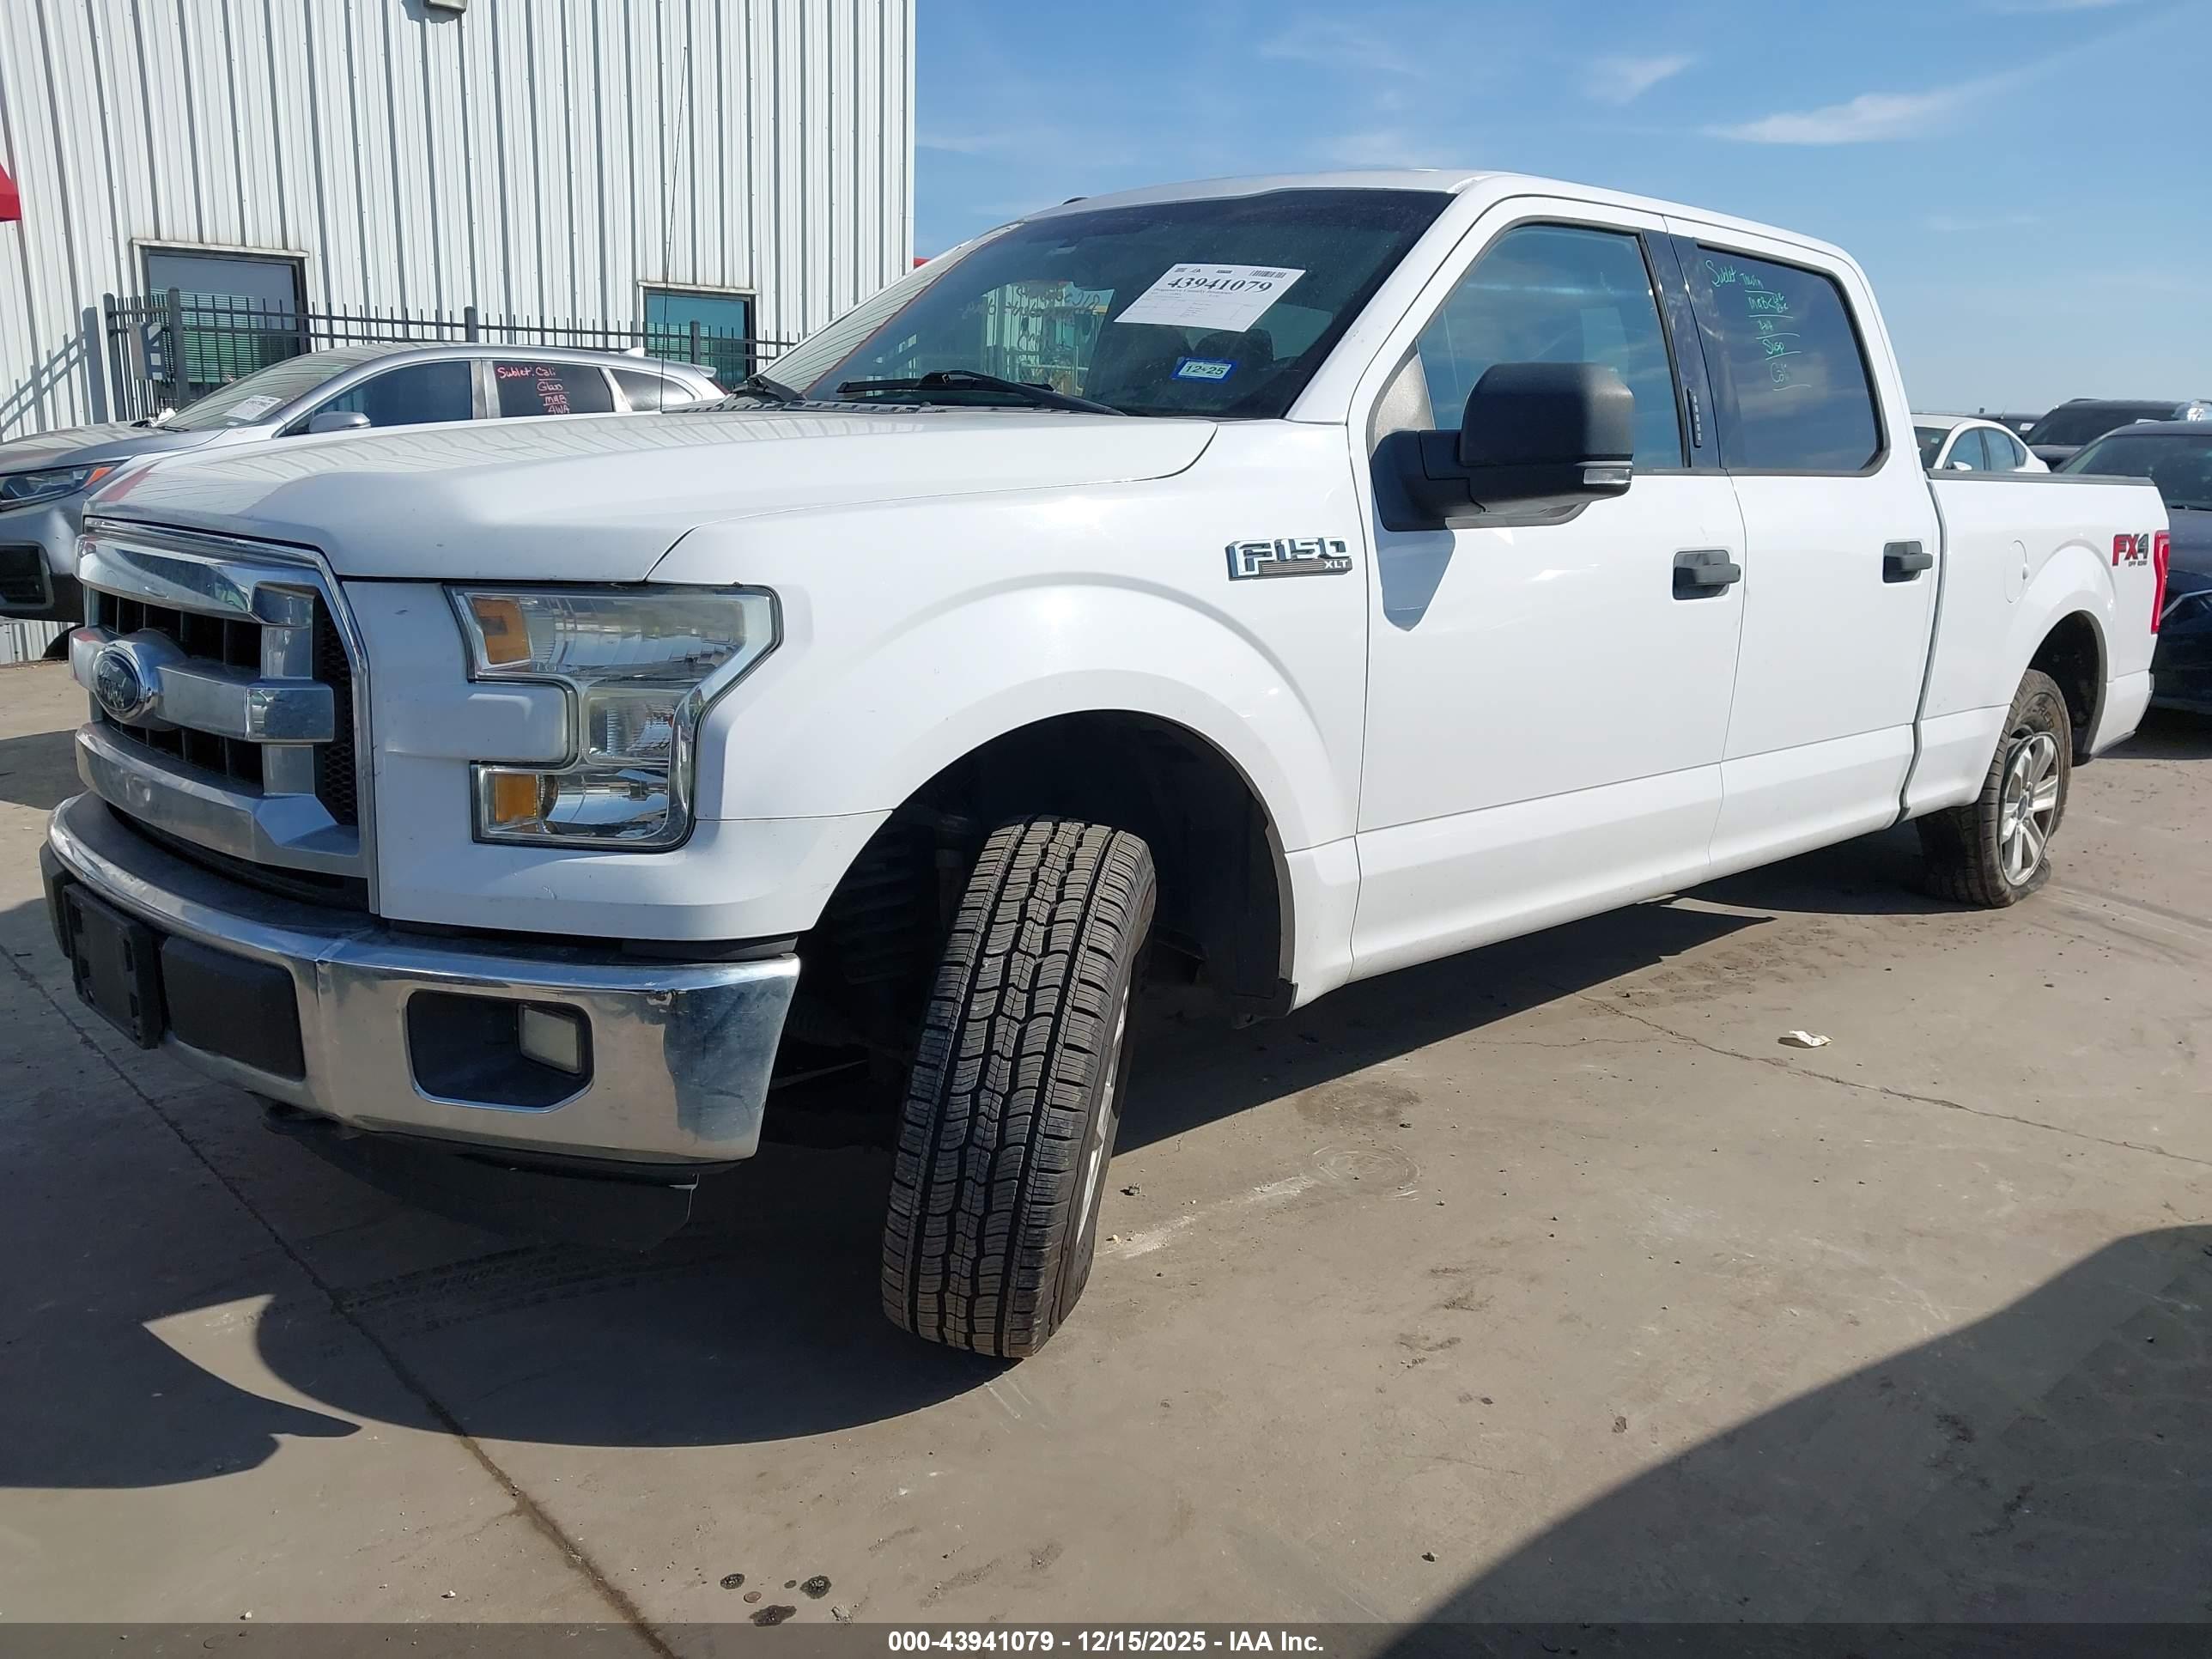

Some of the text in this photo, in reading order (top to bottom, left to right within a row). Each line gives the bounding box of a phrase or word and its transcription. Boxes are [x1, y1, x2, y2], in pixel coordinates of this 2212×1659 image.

[1168, 277, 1273, 294] 43941079
[2112, 533, 2149, 566] FX4
[1323, 559, 1348, 568] XLT
